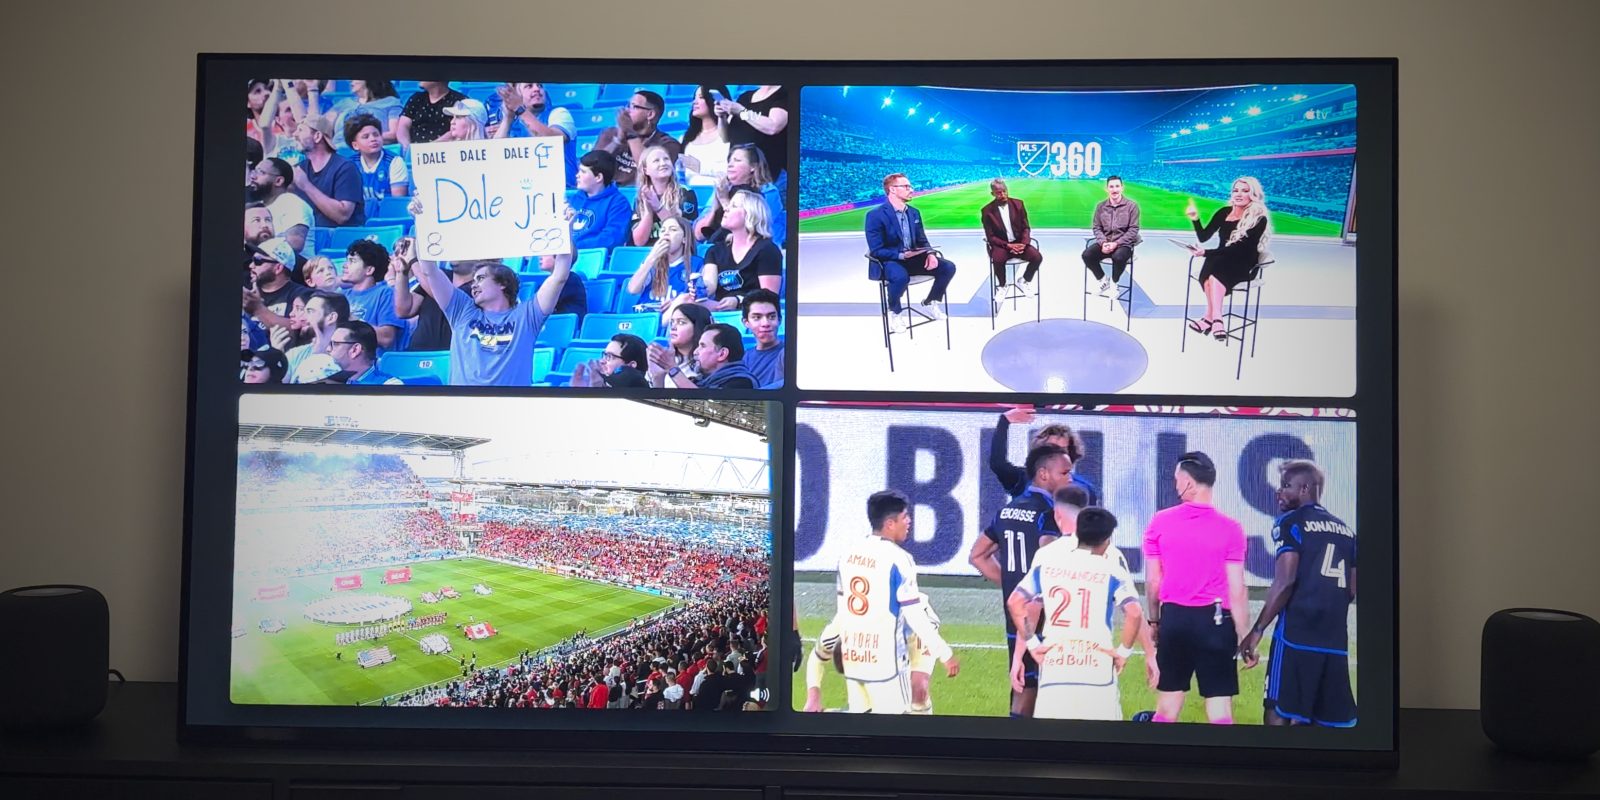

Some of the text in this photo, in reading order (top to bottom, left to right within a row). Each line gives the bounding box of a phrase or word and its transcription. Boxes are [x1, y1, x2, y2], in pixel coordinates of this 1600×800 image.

[1316, 109, 1329, 120] tv
[460, 149, 487, 162] DALE
[504, 146, 529, 160] DALE
[1020, 141, 1102, 177] MLS 360
[435, 173, 504, 224] Dale
[427, 227, 564, 257] 8 88
[847, 554, 877, 570] AMAYA
[1004, 529, 1028, 574] 11
[1320, 542, 1347, 589] 4
[1045, 566, 1108, 584] FERNANDEZ
[847, 575, 870, 616] 8
[1048, 584, 1092, 630] 21
[850, 648, 878, 664] Bulls
[1045, 653, 1099, 668] ed Bulls
